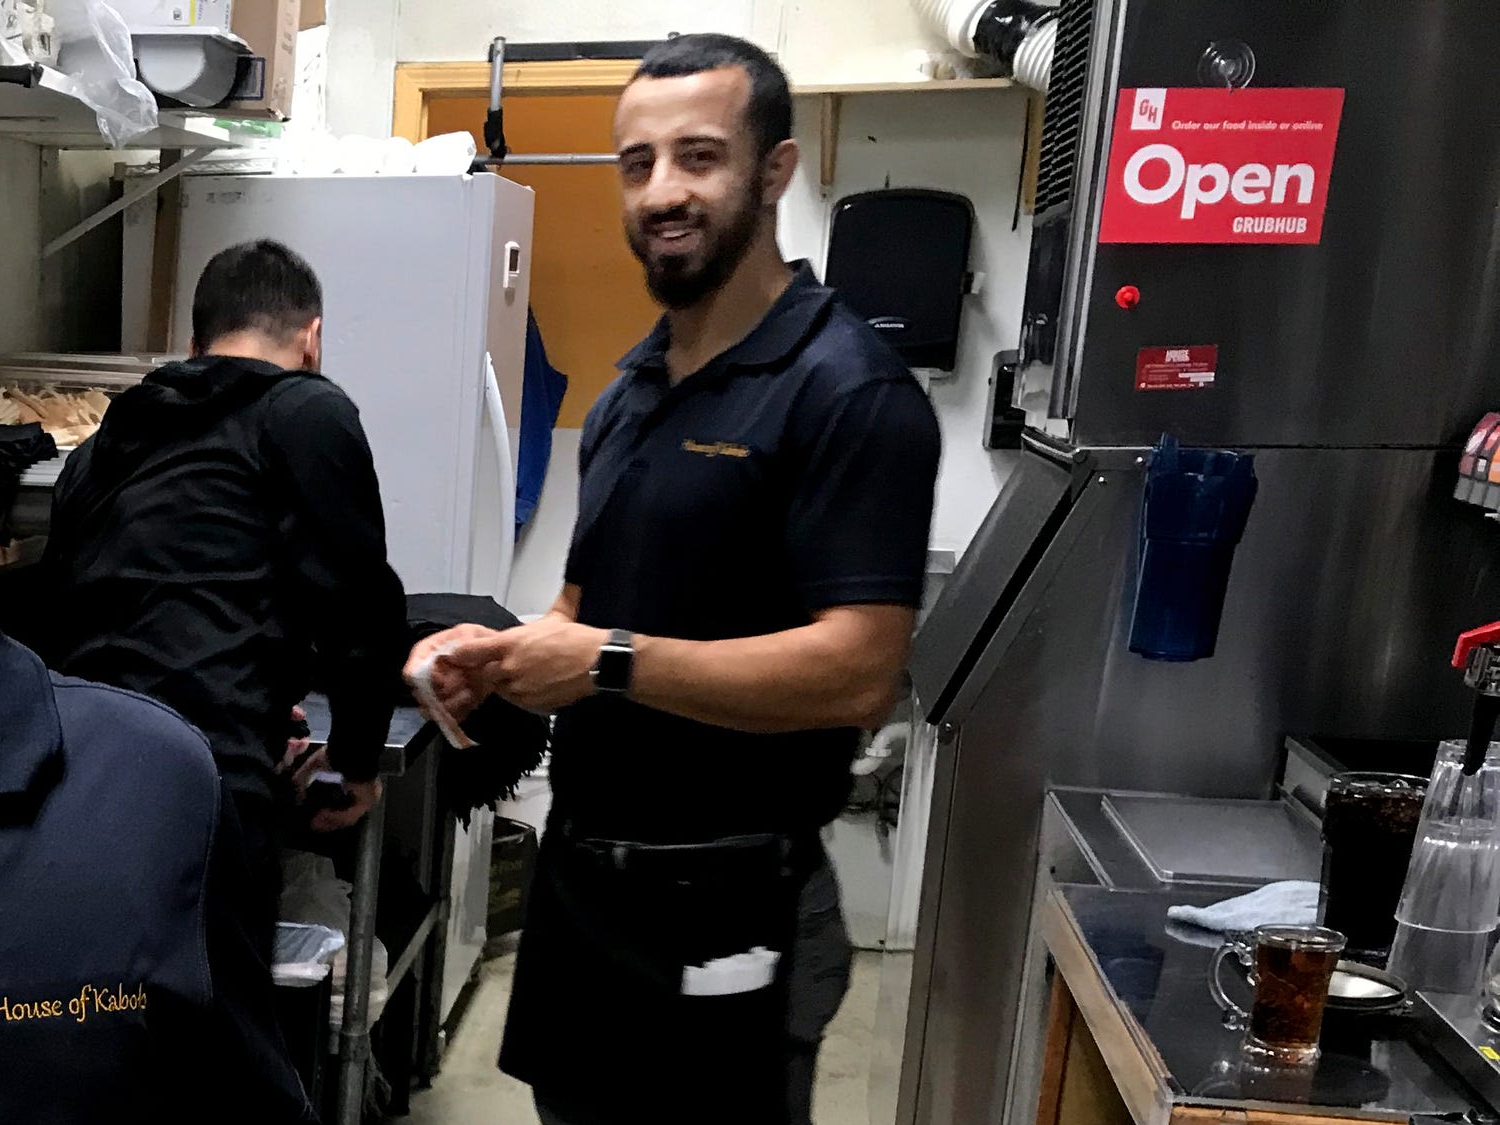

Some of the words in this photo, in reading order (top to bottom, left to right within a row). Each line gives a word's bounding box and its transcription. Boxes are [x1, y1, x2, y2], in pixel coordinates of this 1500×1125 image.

[1171, 120, 1201, 130] Order
[1203, 121, 1220, 130] our
[1222, 120, 1246, 130] food
[1248, 120, 1278, 130] inside
[1279, 121, 1290, 130] or
[1292, 120, 1324, 130] online
[1123, 143, 1315, 219] Open
[1232, 216, 1307, 233] GRUBHUB
[68, 984, 92, 1023] of
